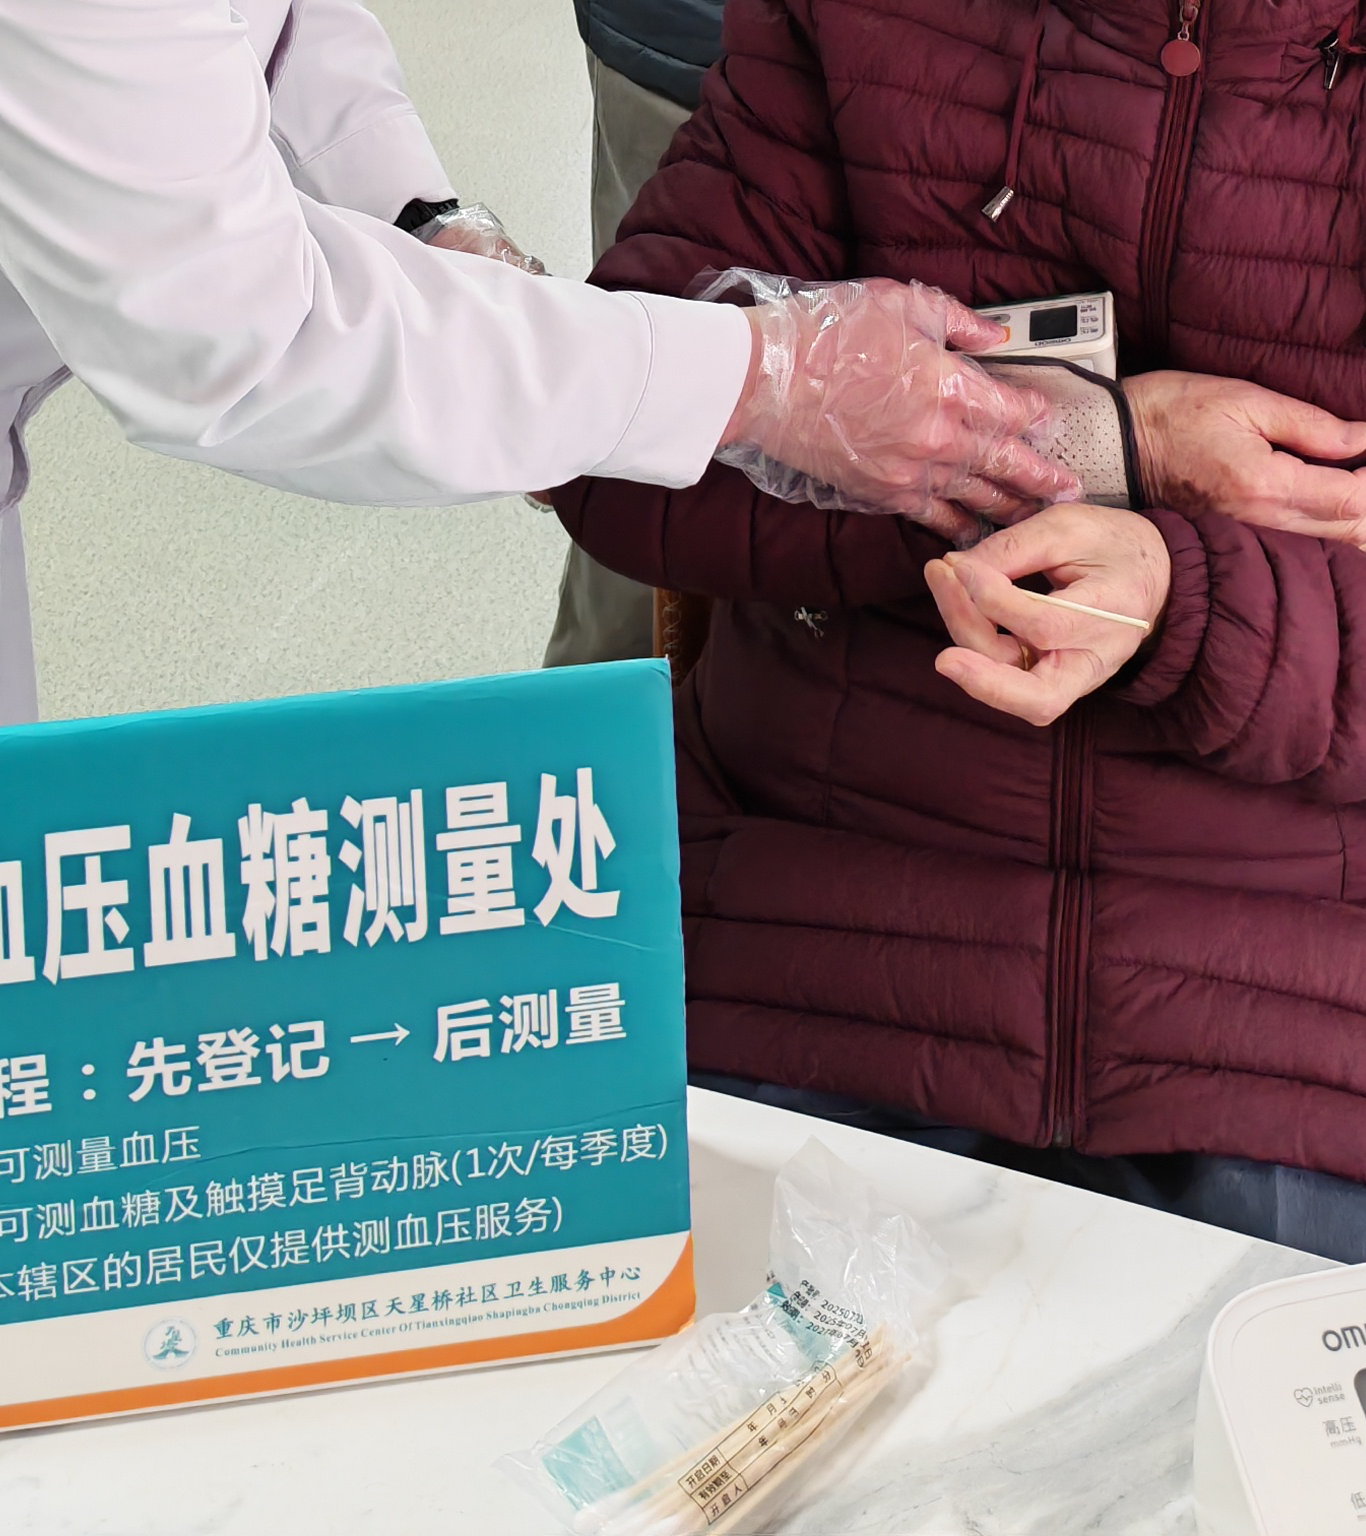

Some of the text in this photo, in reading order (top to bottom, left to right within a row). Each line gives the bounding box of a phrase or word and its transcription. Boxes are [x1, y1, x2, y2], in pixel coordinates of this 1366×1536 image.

[432, 982, 627, 1064] 后测量
[213, 1265, 642, 1341] 重庆市沙坪坝区天星桥社区卫生服务中心
[215, 1340, 278, 1357] Community
[281, 1332, 316, 1348] Health
[319, 1327, 358, 1343] Service
[360, 1322, 396, 1337] Center
[544, 1295, 600, 1315] Chongqing
[602, 1290, 641, 1305] District
[1318, 1393, 1346, 1405] sense
[1322, 1416, 1357, 1438] 高压
[1330, 1435, 1363, 1449] mmHg
[686, 1454, 721, 1489] 开启日期
[698, 1470, 733, 1501] 有效期至
